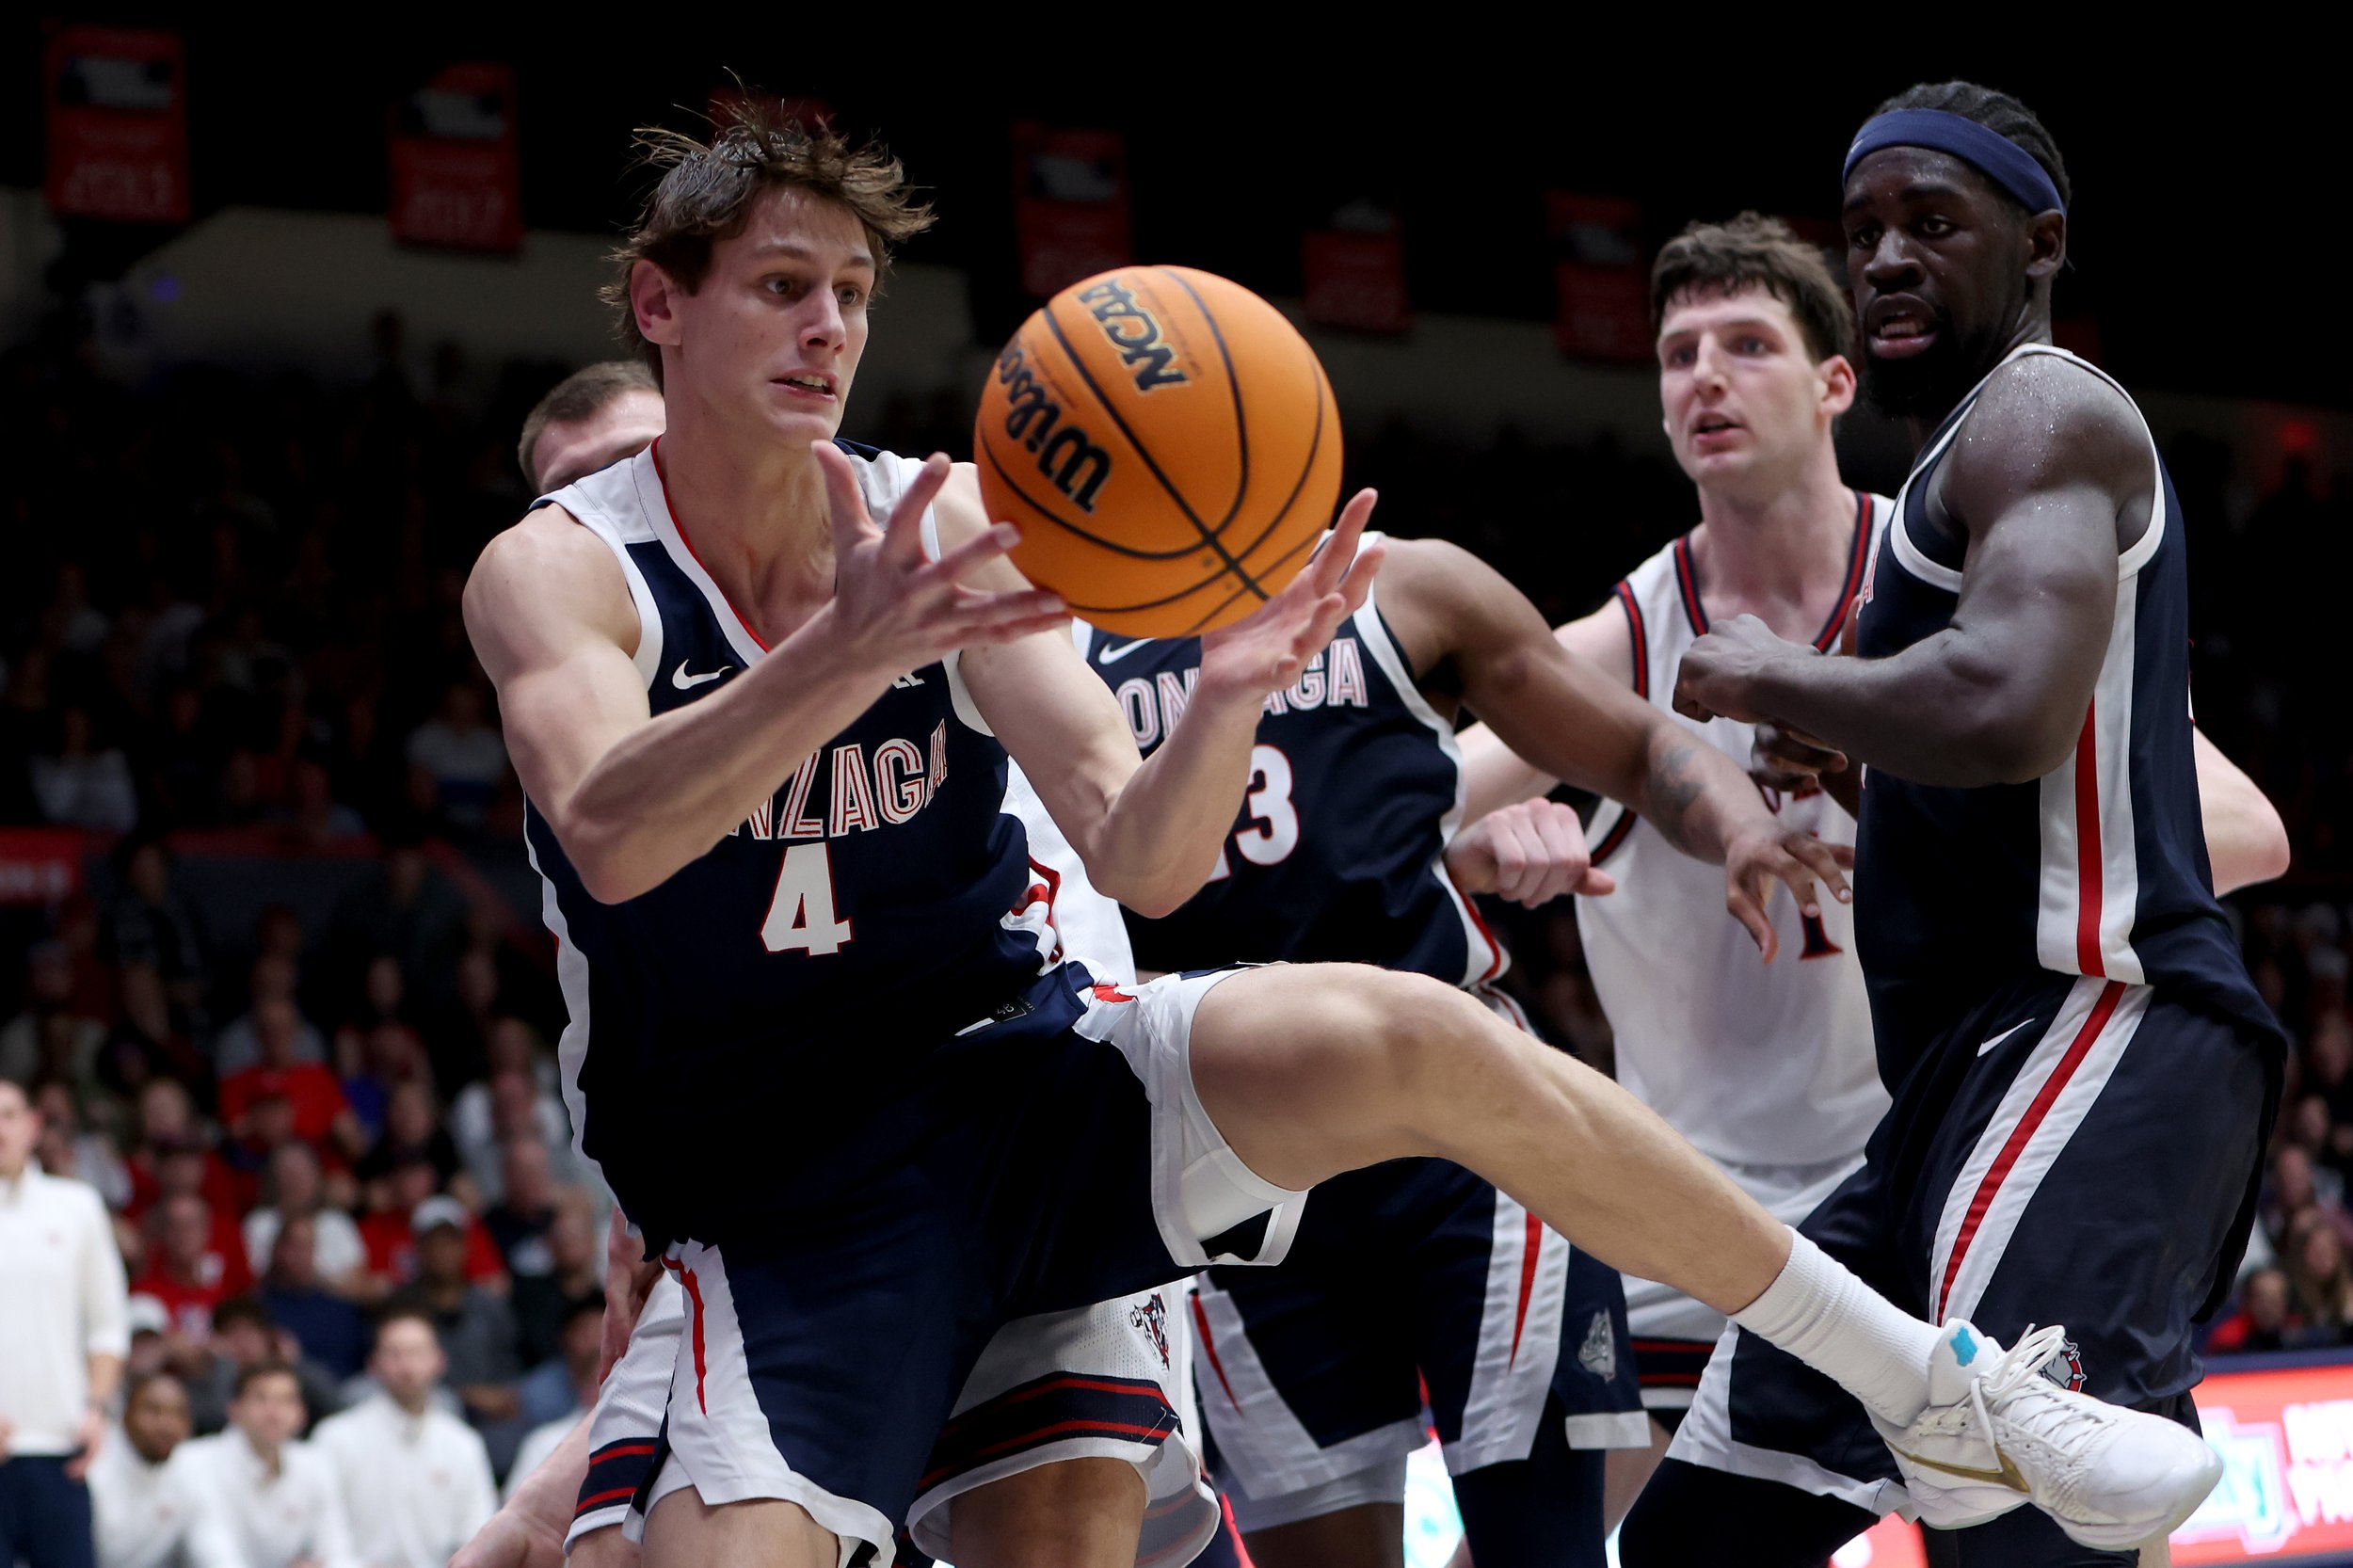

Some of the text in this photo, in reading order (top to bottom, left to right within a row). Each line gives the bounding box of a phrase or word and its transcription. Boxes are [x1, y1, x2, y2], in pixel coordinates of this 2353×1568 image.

[1079, 280, 1189, 394] NCAA
[1207, 743, 1301, 885] 3
[758, 840, 856, 958] 4
